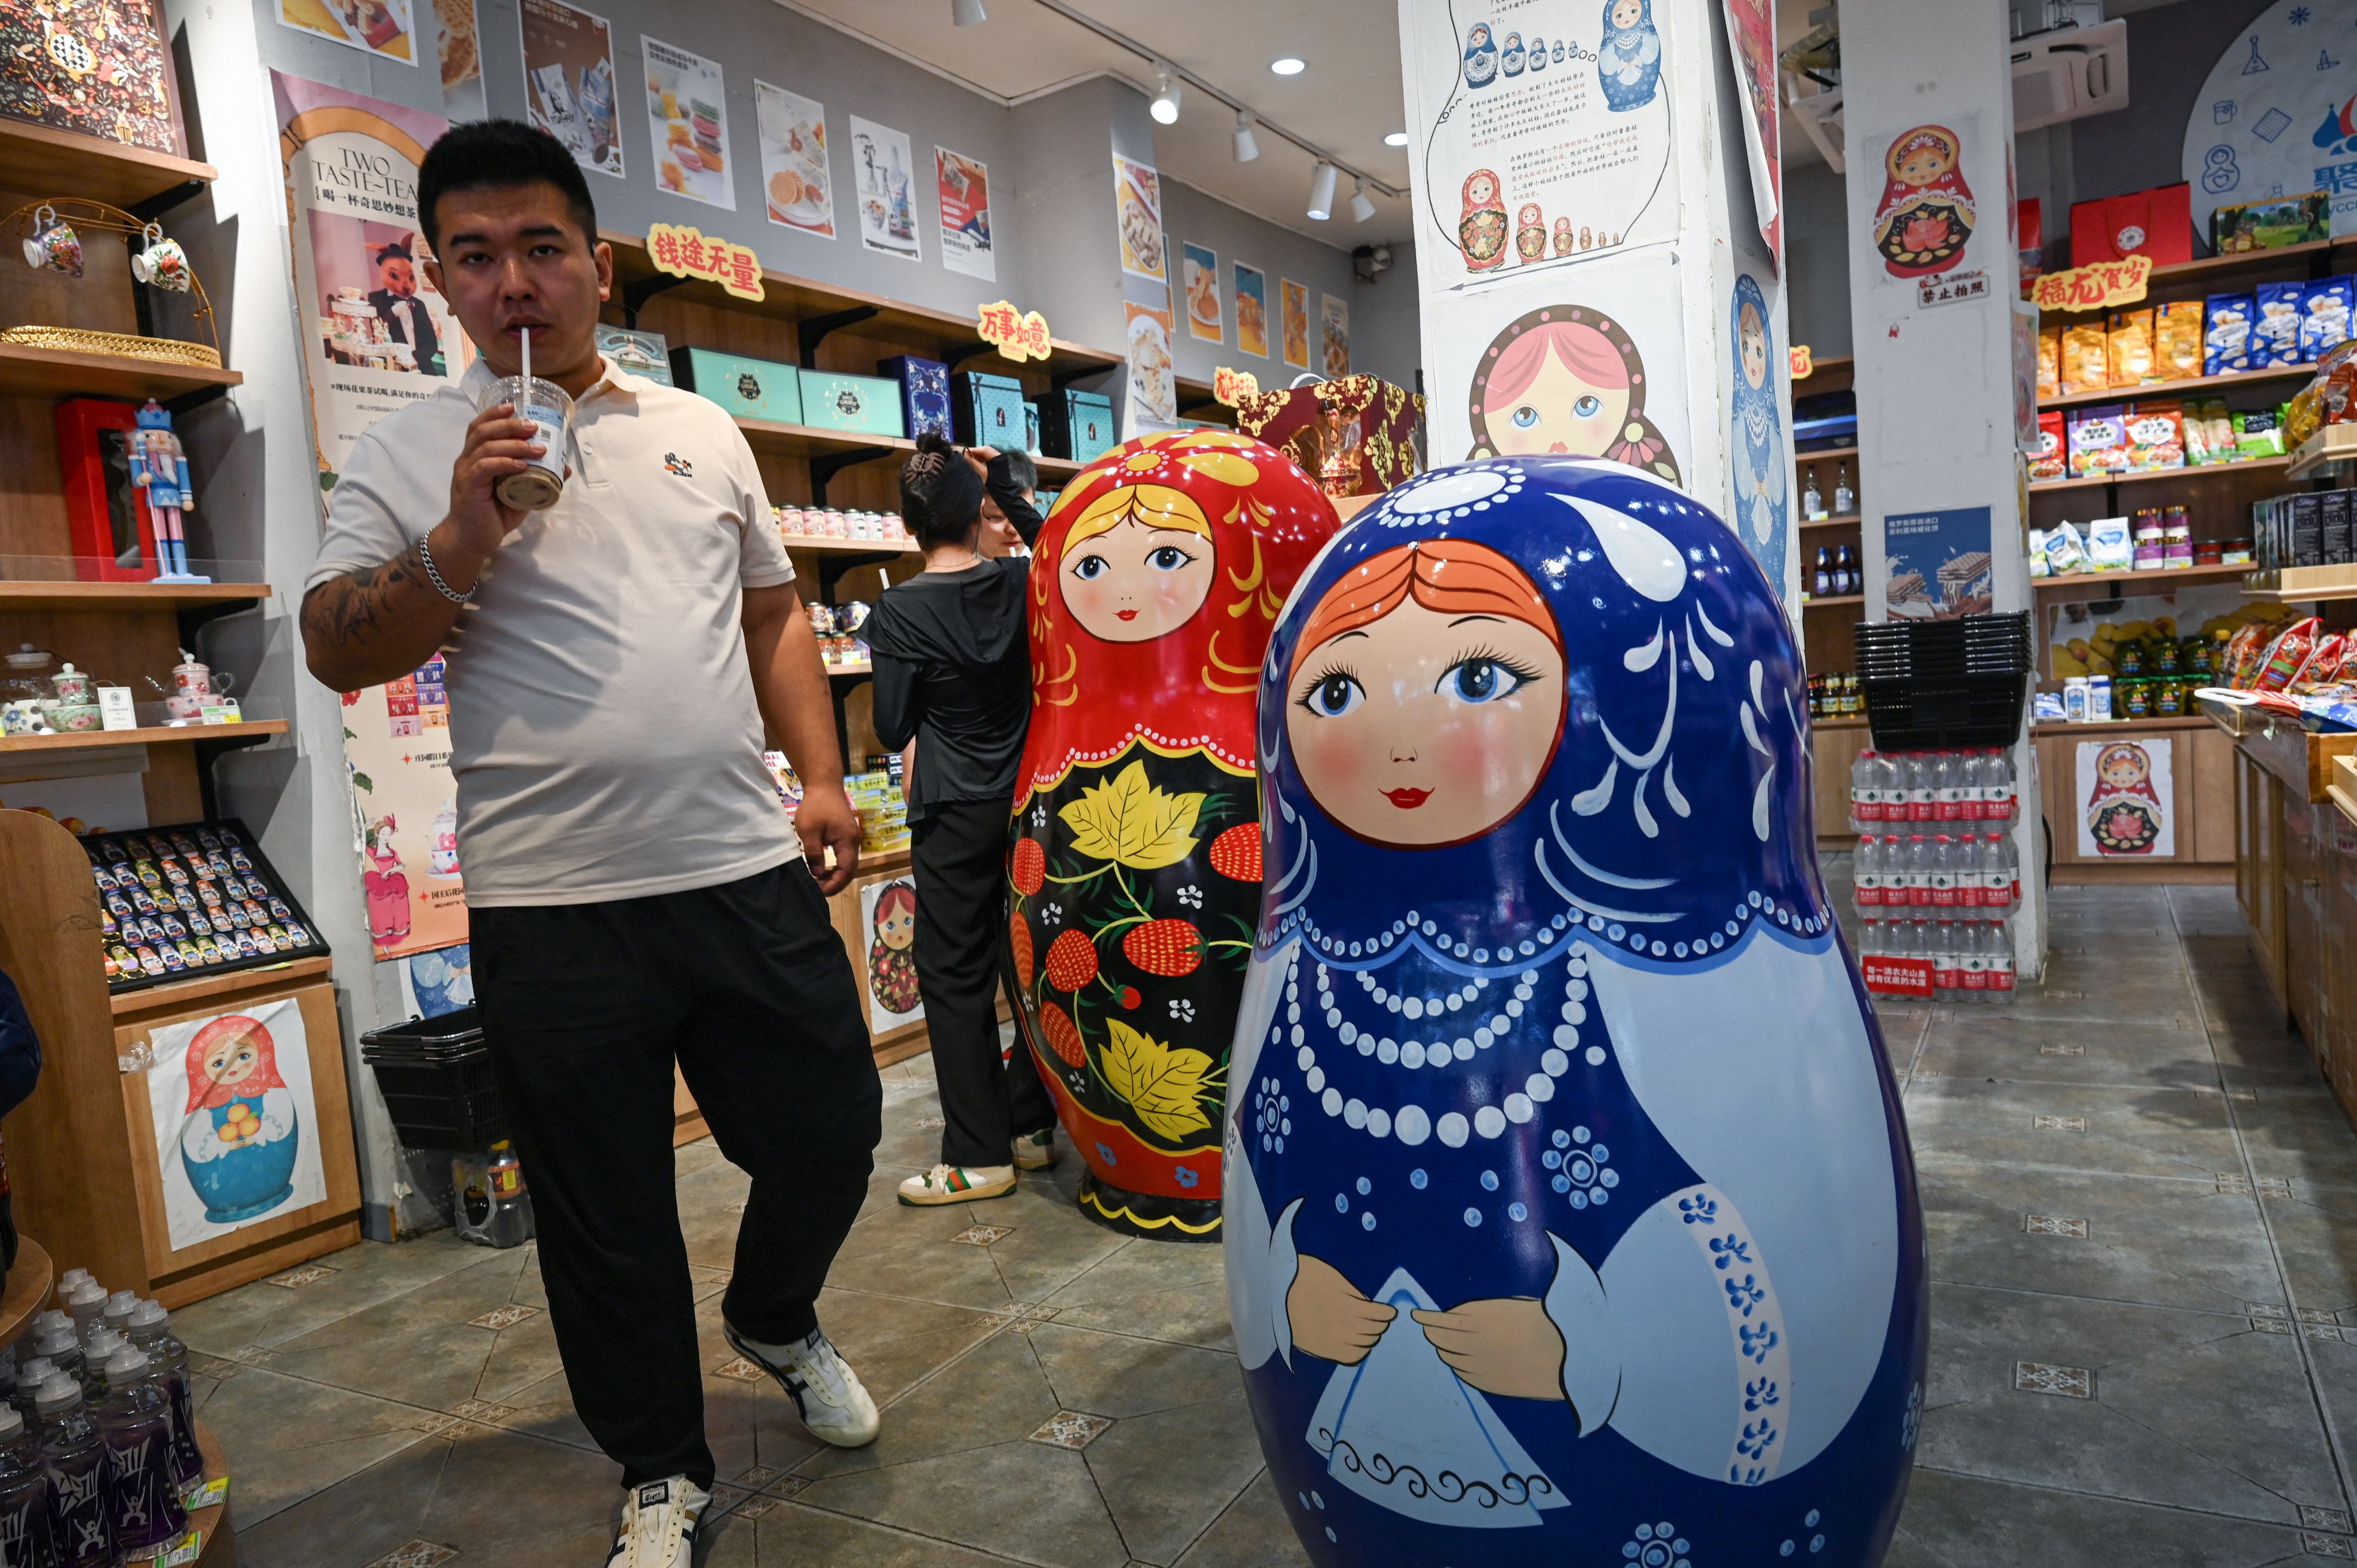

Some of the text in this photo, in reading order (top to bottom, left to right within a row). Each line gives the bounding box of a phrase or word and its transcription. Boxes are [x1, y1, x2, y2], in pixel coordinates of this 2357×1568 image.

[338, 147, 390, 176] TWO
[655, 232, 760, 294] 钱途无量
[1923, 281, 1984, 303] 禁止拍照
[983, 307, 1047, 353] 万事如意
[1867, 966, 1926, 978] 每一滴农夫山泉
[1867, 975, 1926, 987] 都有优质的水源
